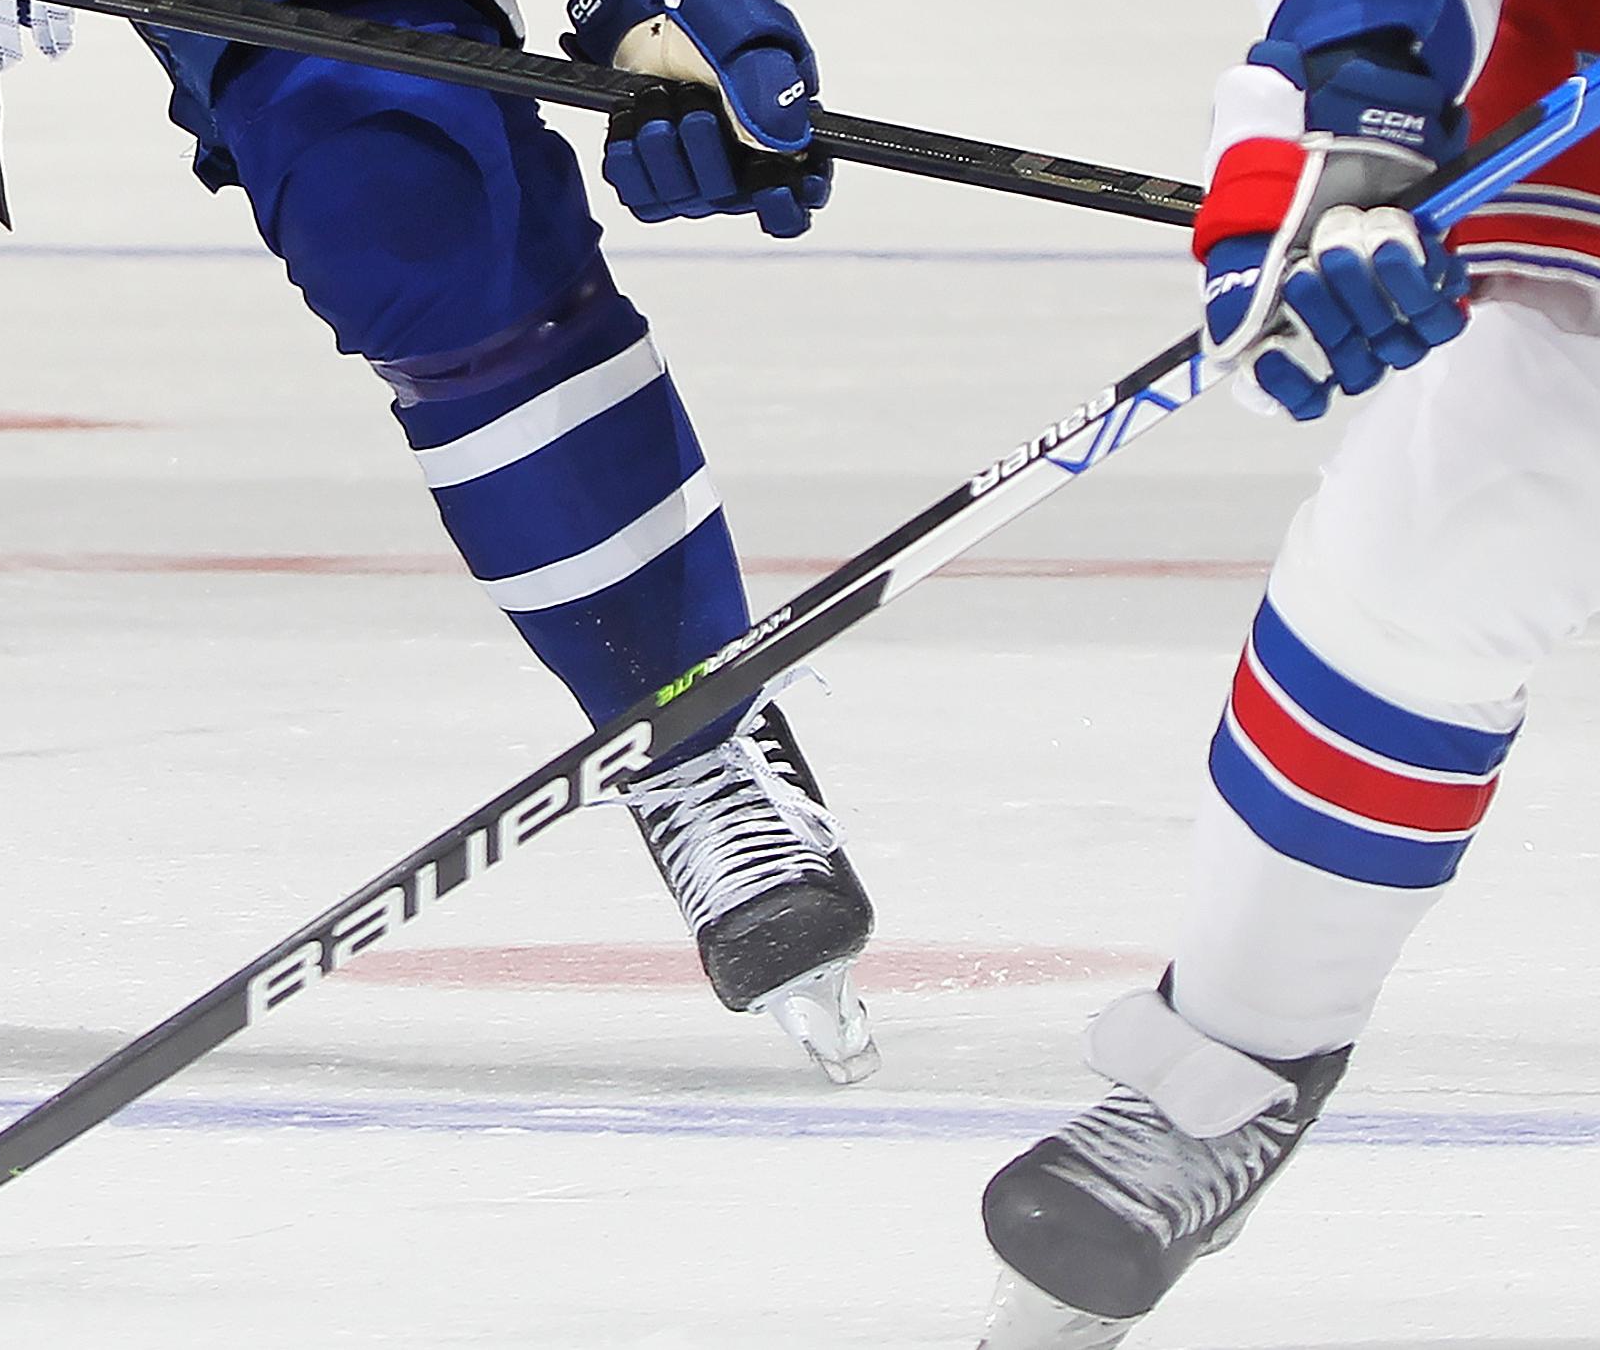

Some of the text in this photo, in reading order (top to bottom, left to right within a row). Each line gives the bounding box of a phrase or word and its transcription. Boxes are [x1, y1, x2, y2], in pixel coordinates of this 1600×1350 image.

[1359, 108, 1426, 131] CCM
[969, 384, 1118, 499] BAUER
[245, 719, 654, 1026] BAUER
